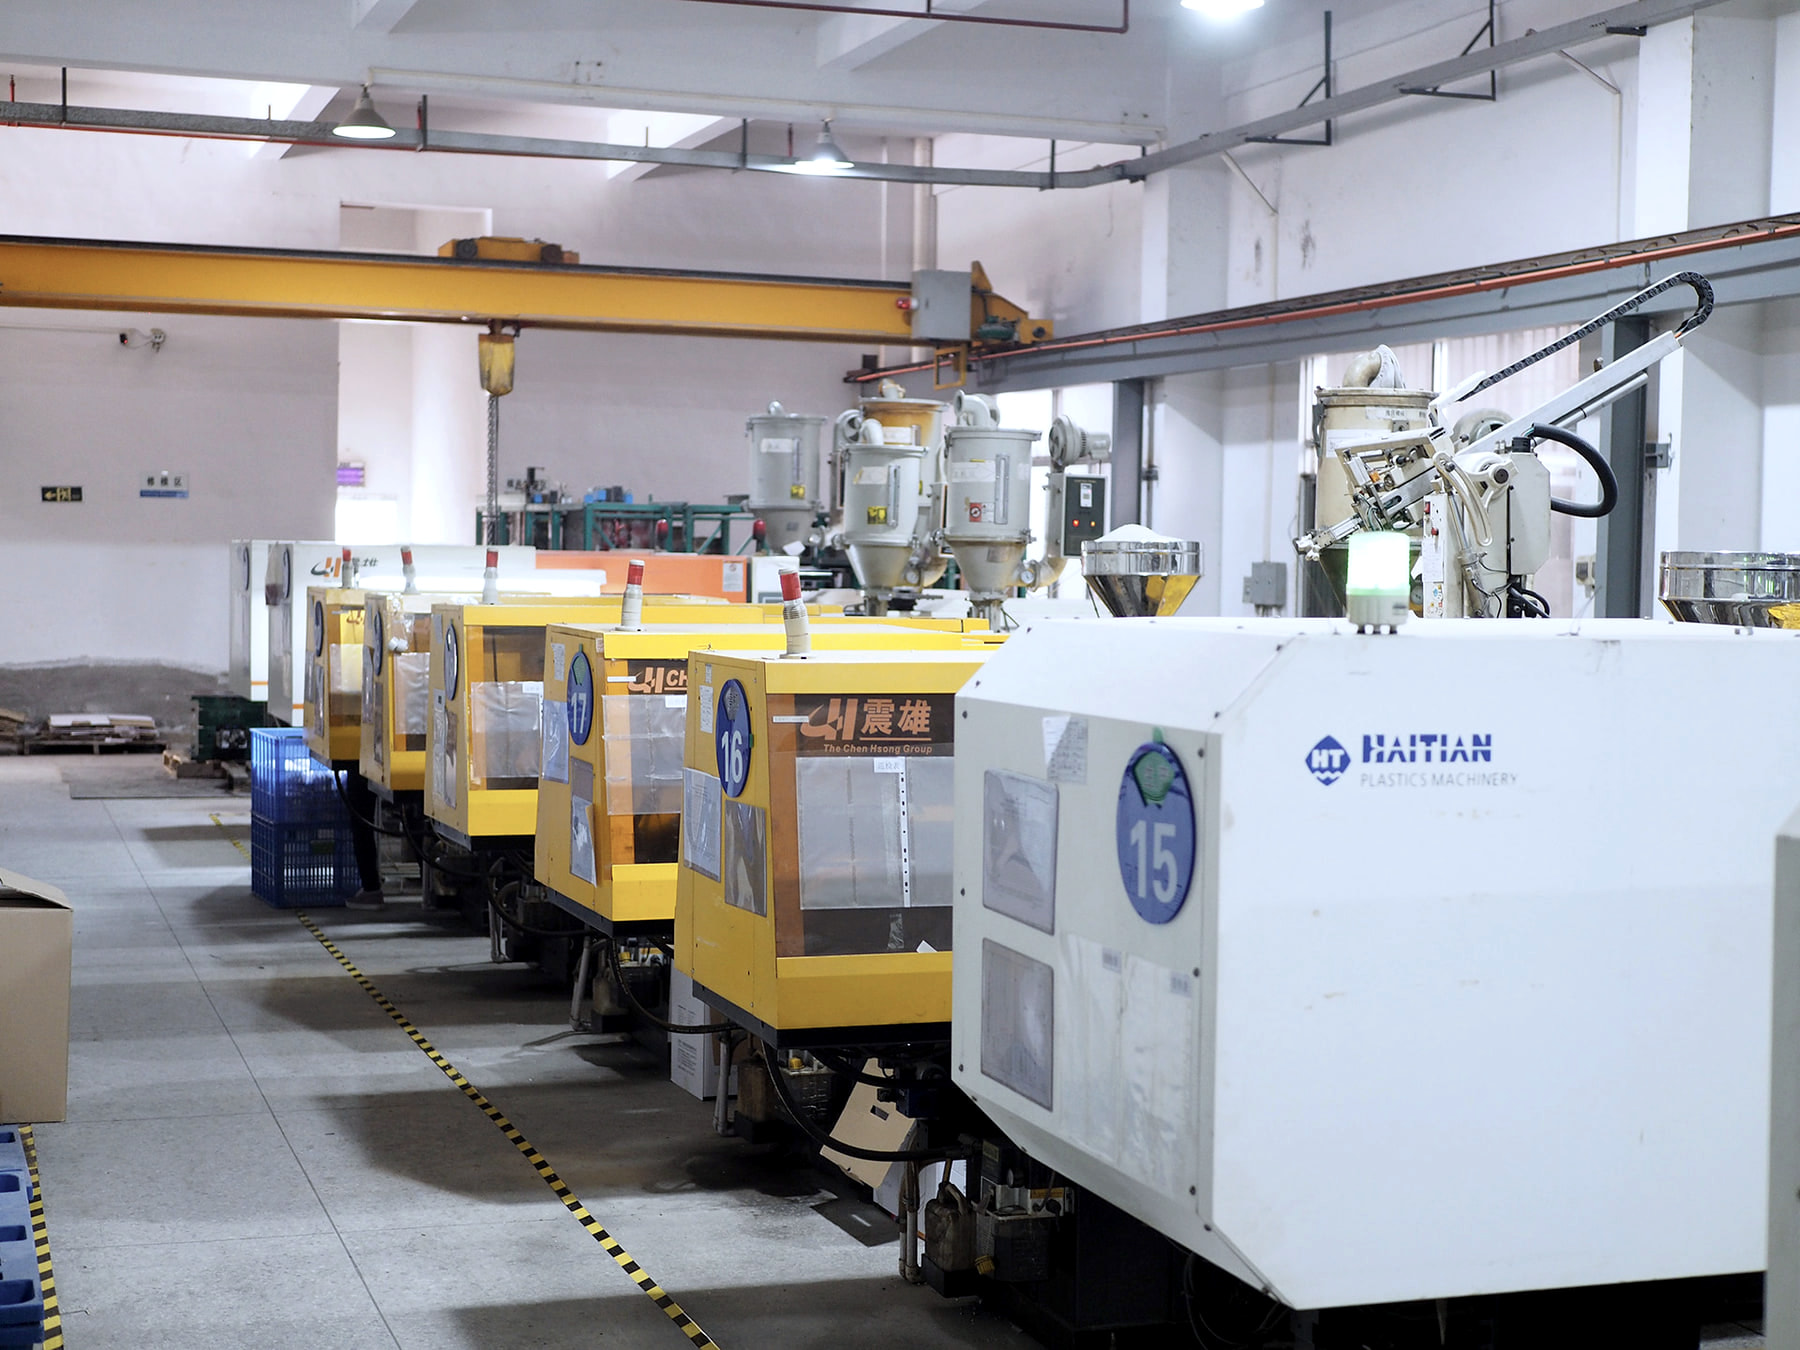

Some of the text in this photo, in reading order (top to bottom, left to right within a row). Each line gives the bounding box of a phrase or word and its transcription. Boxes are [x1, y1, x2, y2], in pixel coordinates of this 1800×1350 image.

[571, 692, 587, 734] 17
[861, 698, 932, 735] 震雄
[721, 730, 743, 784] 16
[824, 743, 933, 755] The Chen Hsong Group
[1362, 734, 1492, 763] HAITIAN
[1360, 773, 1519, 788] PLASTICS MACHINERY
[1130, 820, 1178, 903] 15
